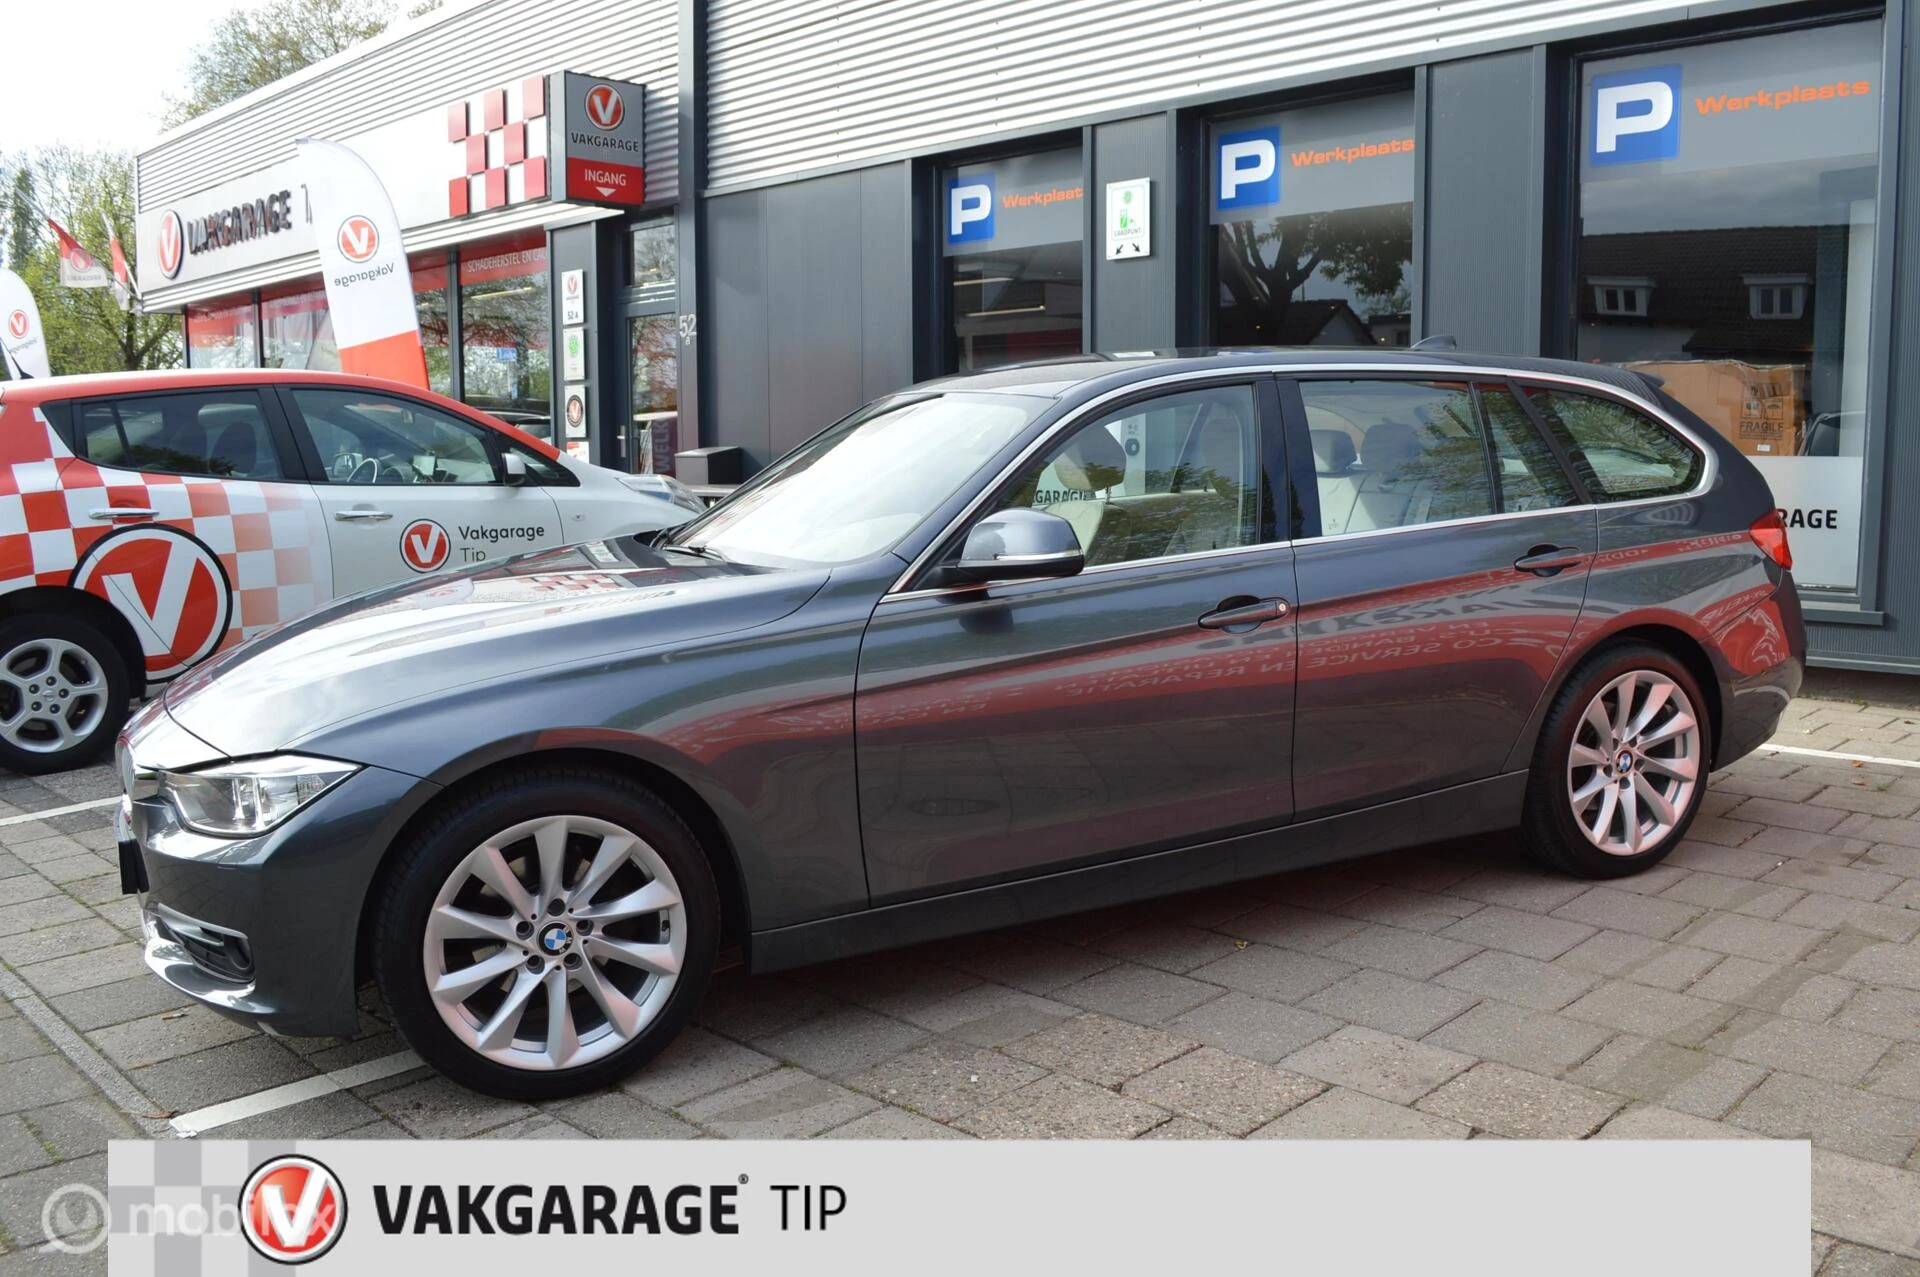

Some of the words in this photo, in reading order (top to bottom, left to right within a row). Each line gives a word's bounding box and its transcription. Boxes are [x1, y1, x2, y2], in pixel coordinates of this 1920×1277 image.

[1695, 79, 1871, 116] Werkplaats
[571, 132, 640, 152] VAKGARAGE
[1291, 137, 1415, 168] Werkplaats
[584, 168, 626, 186] INGANG
[187, 189, 292, 255] VAKGARAGE
[679, 314, 697, 338] 52
[1739, 421, 1784, 433] FRAGILE
[458, 525, 545, 543] Vakgarage
